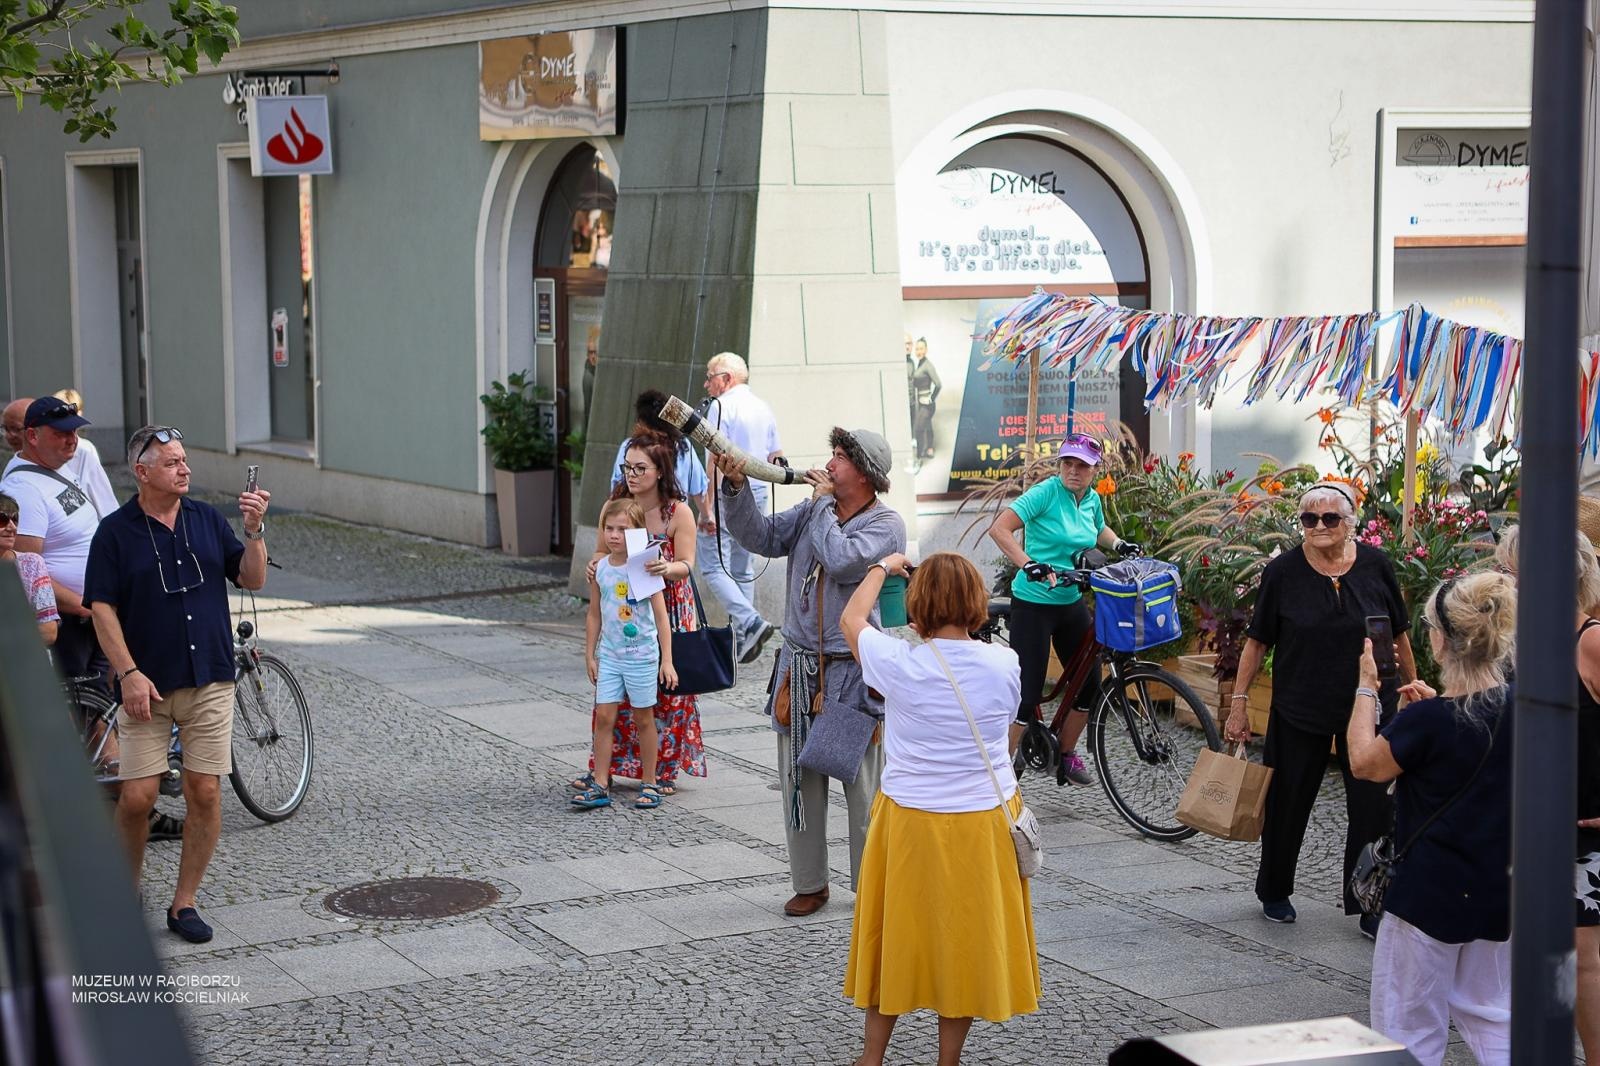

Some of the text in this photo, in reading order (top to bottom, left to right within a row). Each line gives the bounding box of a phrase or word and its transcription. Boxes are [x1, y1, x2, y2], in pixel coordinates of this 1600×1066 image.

[990, 171, 1065, 195] DYMEL
[977, 225, 1050, 245] dymel...
[919, 241, 951, 257] it's
[956, 242, 989, 257] not
[992, 240, 1032, 260] just
[1037, 243, 1049, 256] a
[944, 255, 1082, 274] it's a lifestyle.
